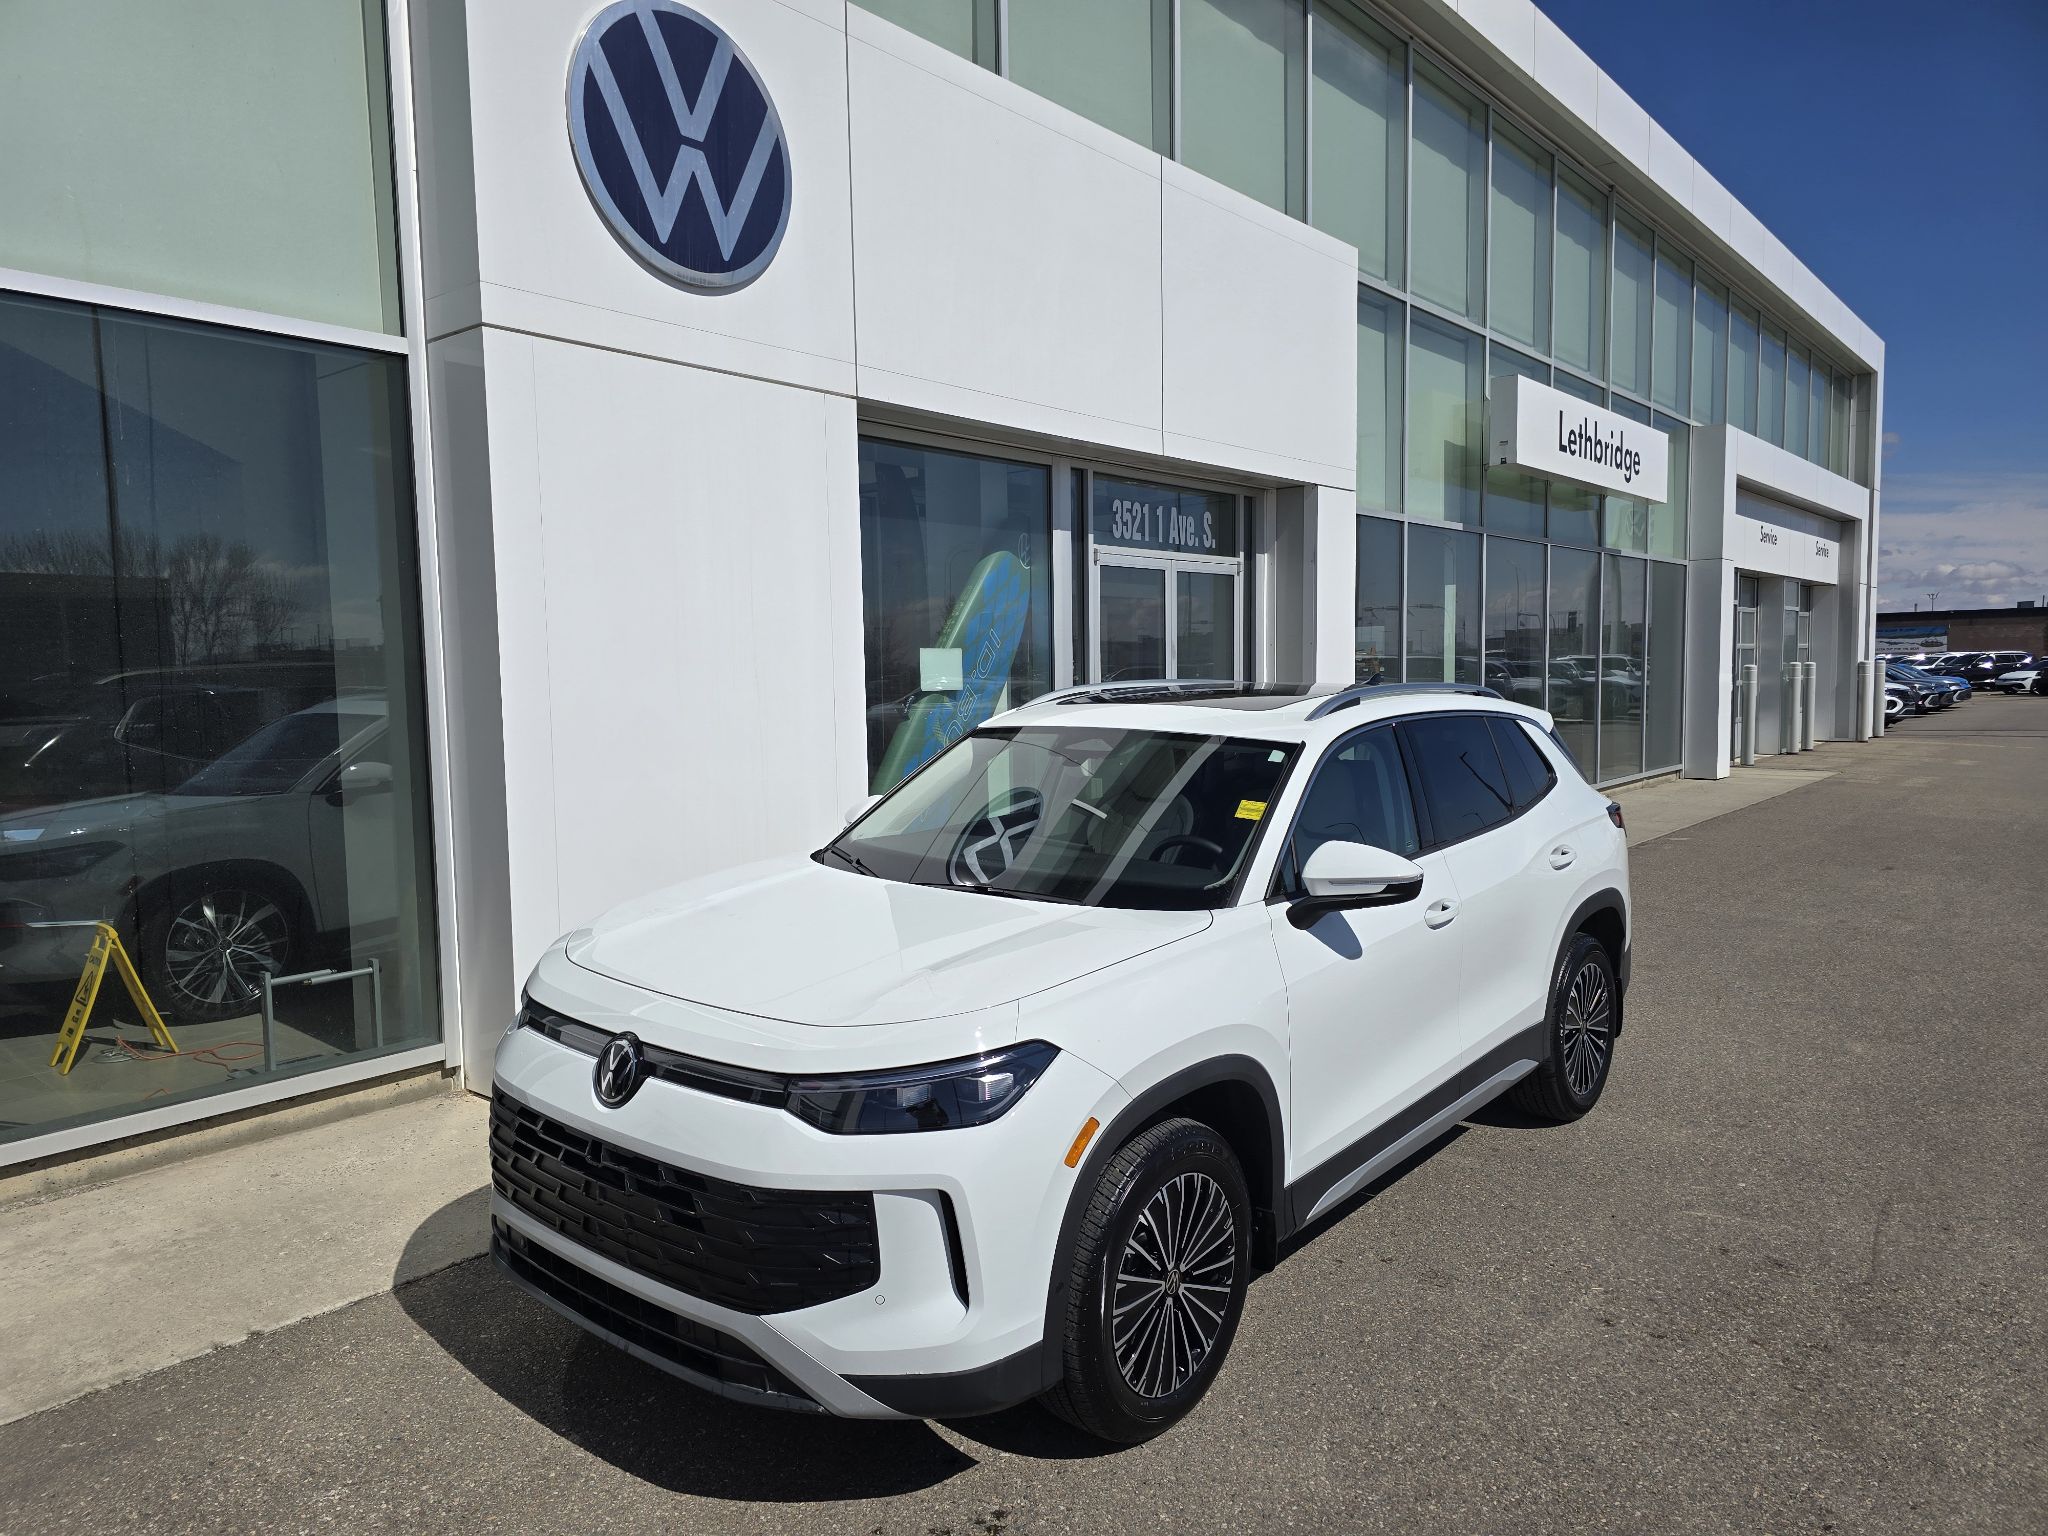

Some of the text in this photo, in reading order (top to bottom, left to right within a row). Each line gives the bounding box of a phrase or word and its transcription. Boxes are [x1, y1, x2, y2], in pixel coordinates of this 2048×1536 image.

[1558, 410, 1641, 484] Lethbridge
[1112, 498, 1216, 549] 3521 1 Ave. S.
[1760, 525, 1778, 546] Service
[1815, 540, 1829, 558] Service
